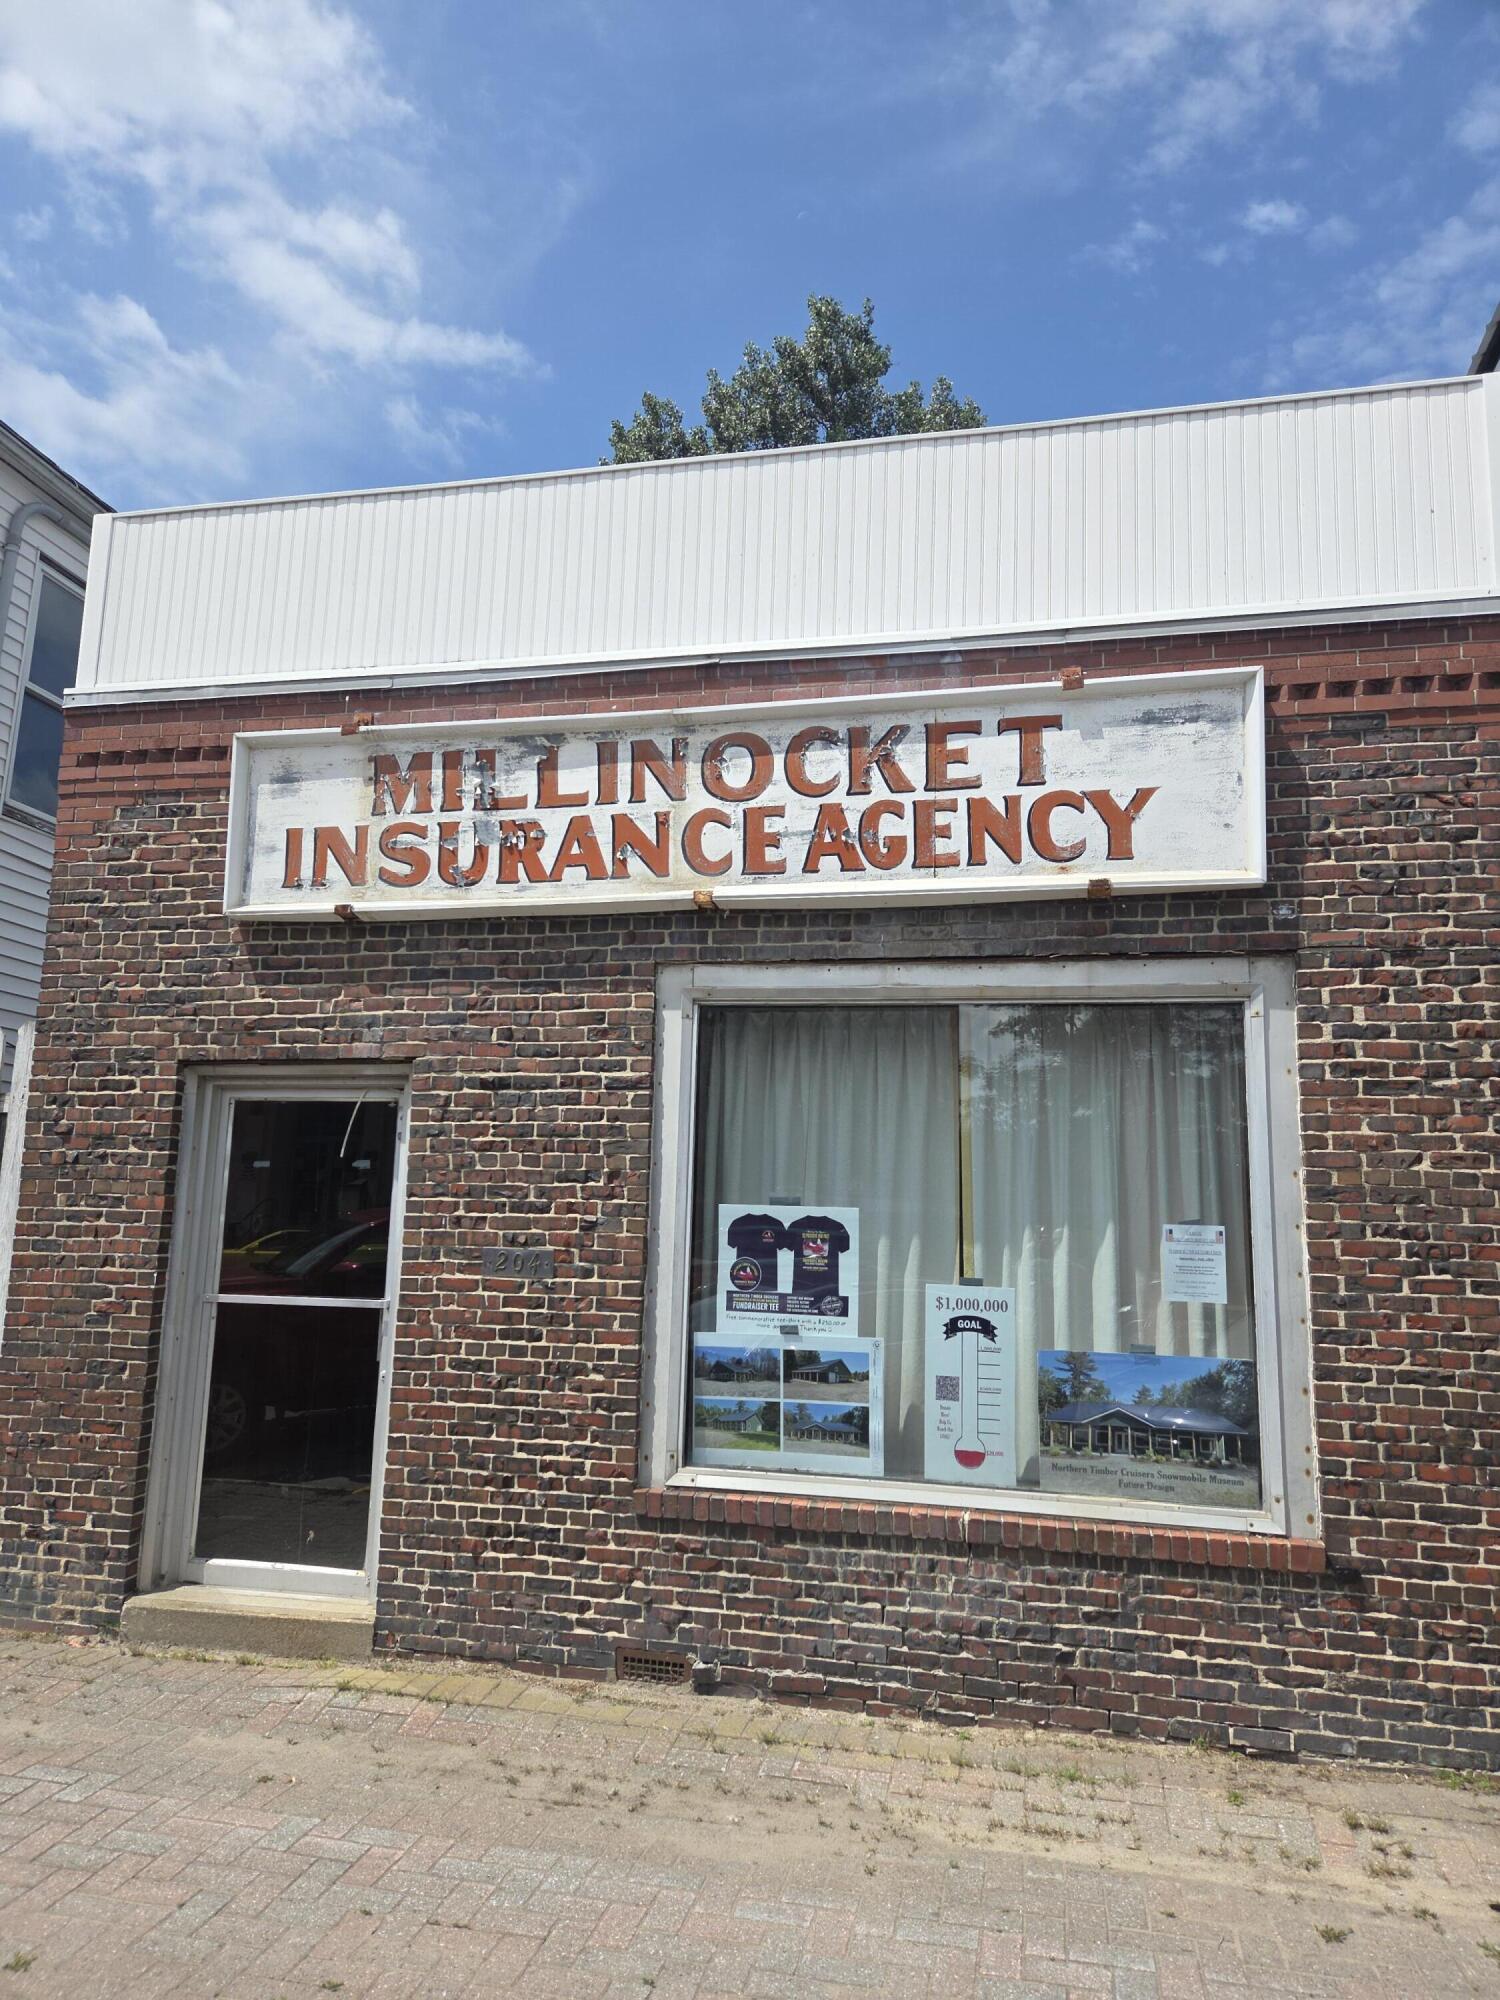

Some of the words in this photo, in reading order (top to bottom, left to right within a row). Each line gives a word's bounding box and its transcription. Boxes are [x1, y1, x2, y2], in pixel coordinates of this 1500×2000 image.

[370, 714, 1063, 817] MILLINOCKET
[281, 803, 788, 889] INSURANCE
[802, 786, 1162, 874] AGENCY
[494, 1250, 541, 1276] 204
[732, 1301, 768, 1311] FUNDRAISER
[768, 1302, 779, 1312] TEE
[936, 1296, 1008, 1312] $1,000,000
[957, 1319, 982, 1329] GOAL
[1051, 1463, 1088, 1473] Northern
[1089, 1465, 1118, 1476] Timber
[1120, 1468, 1155, 1479] Cruisers
[1157, 1470, 1206, 1483] Snowmobile
[1209, 1475, 1245, 1486] Museum
[1118, 1479, 1145, 1490] Future
[1146, 1481, 1175, 1493] Design
